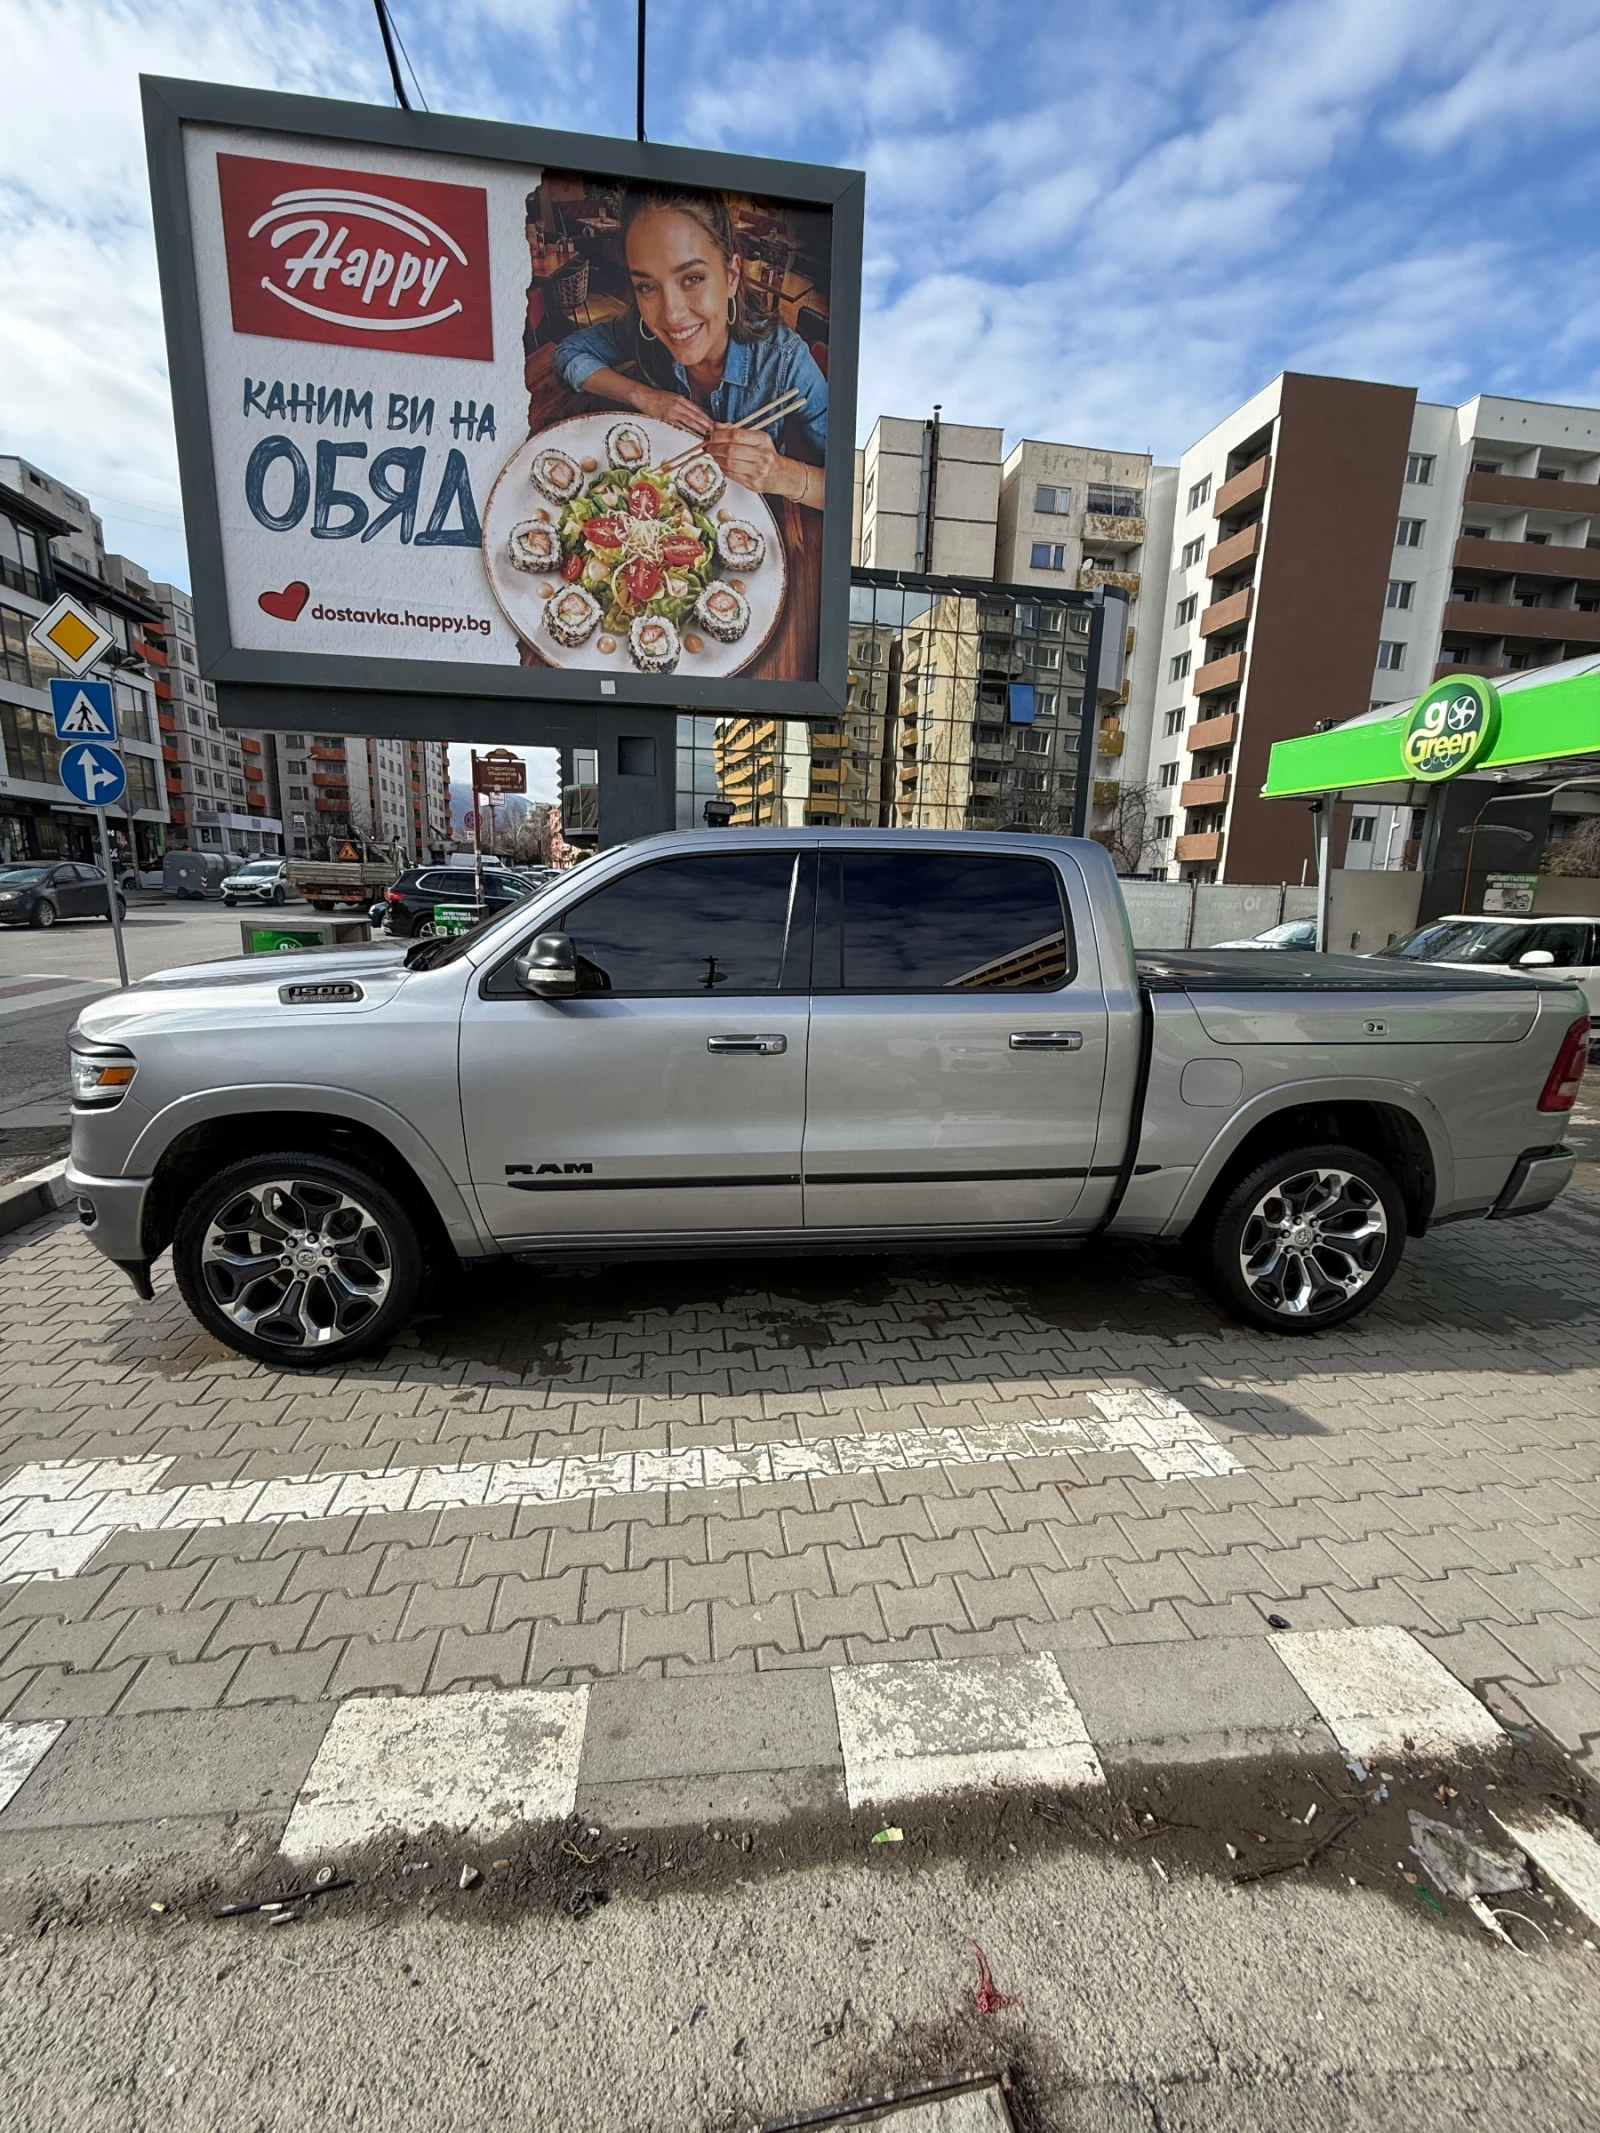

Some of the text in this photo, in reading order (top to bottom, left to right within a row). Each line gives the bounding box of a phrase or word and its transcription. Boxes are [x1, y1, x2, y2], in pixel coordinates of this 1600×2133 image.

[270, 218, 450, 308] Happy
[243, 376, 497, 442] КАНИМ ВИ НА
[243, 434, 483, 548] ОБЯД
[311, 602, 492, 636] dostavka.happy.bg
[1406, 728, 1477, 764] Green
[293, 986, 350, 996] 1500
[504, 1163, 593, 1175] RAM
